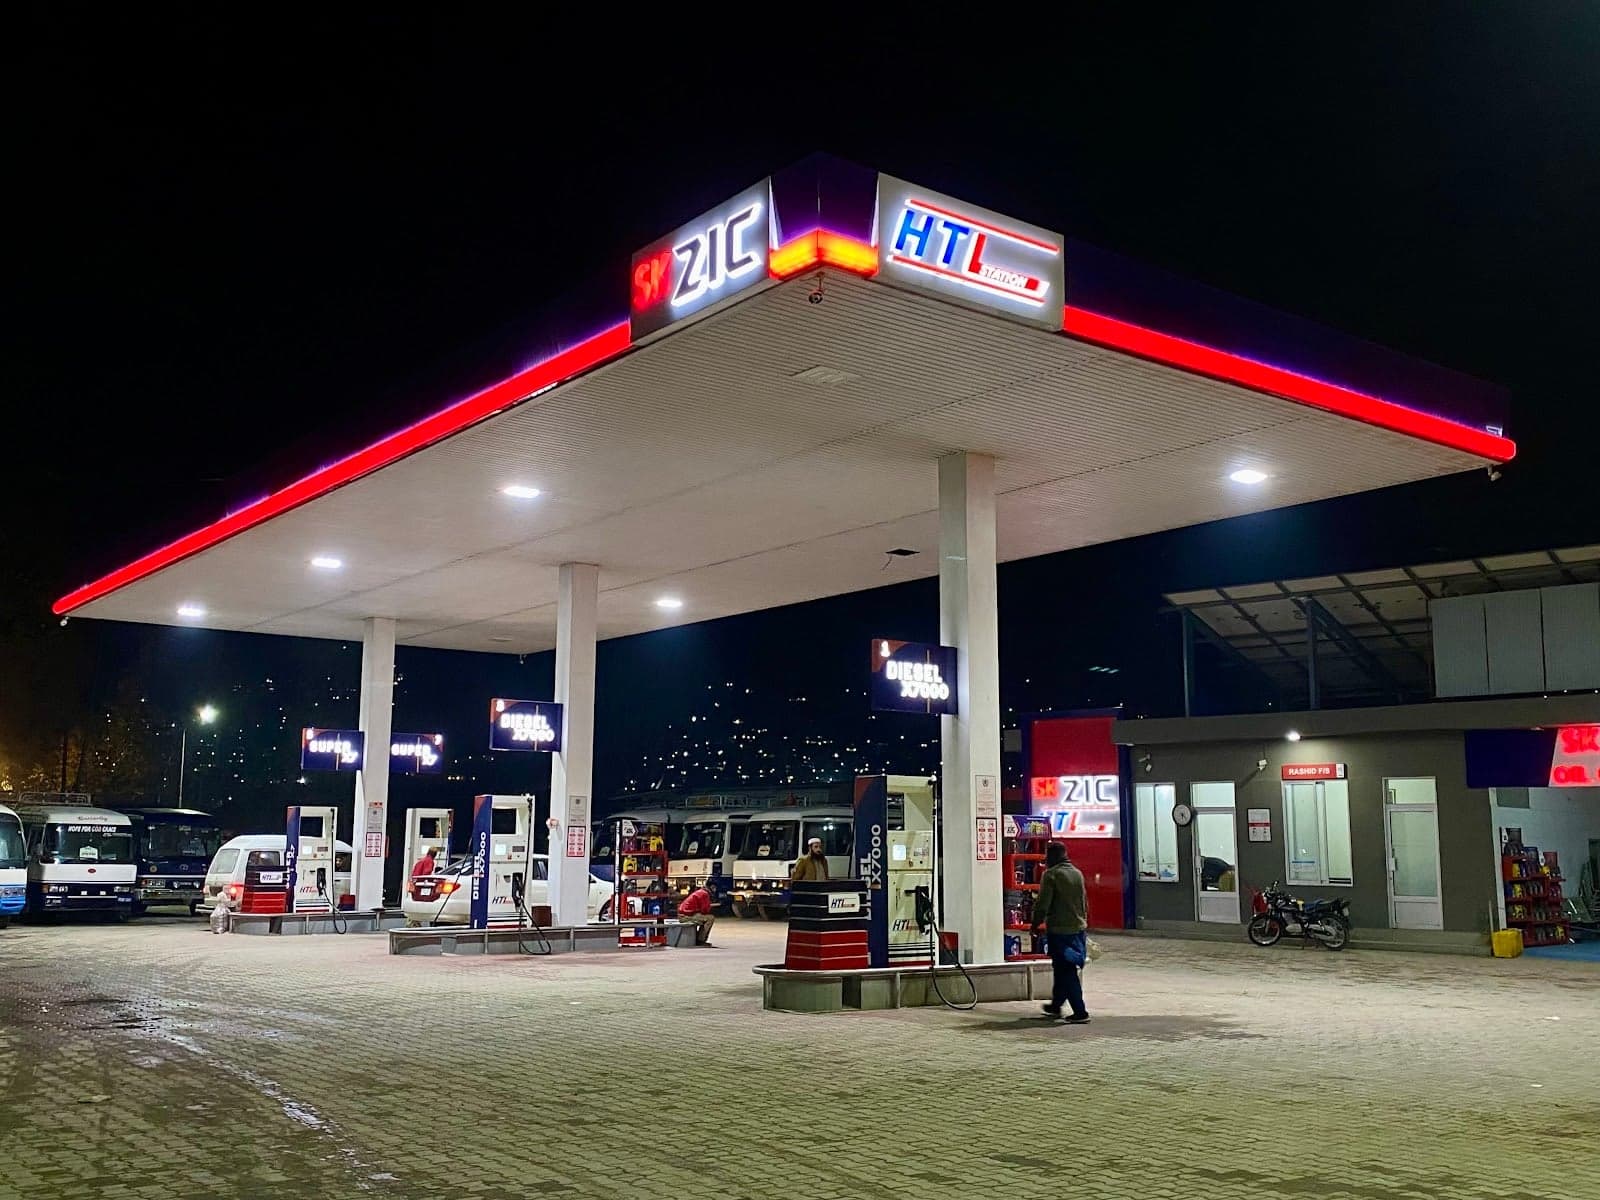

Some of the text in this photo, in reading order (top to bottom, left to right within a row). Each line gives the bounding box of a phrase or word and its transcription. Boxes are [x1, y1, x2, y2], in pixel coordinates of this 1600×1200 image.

[891, 208, 987, 275] HTL
[634, 203, 762, 307] SK ZIC
[981, 265, 1029, 289] STATION
[886, 660, 943, 684] DIESEL
[901, 680, 949, 700] X7000
[501, 713, 550, 730] DIESEL
[309, 740, 352, 754] SUPER
[391, 743, 431, 758] SUPER
[1561, 727, 1600, 753] SK
[1288, 768, 1317, 776] RASHID
[1554, 765, 1590, 784] OIL
[1034, 777, 1115, 804] SK ZIC
[871, 824, 882, 884] X7000
[473, 852, 481, 900] DIESEL
